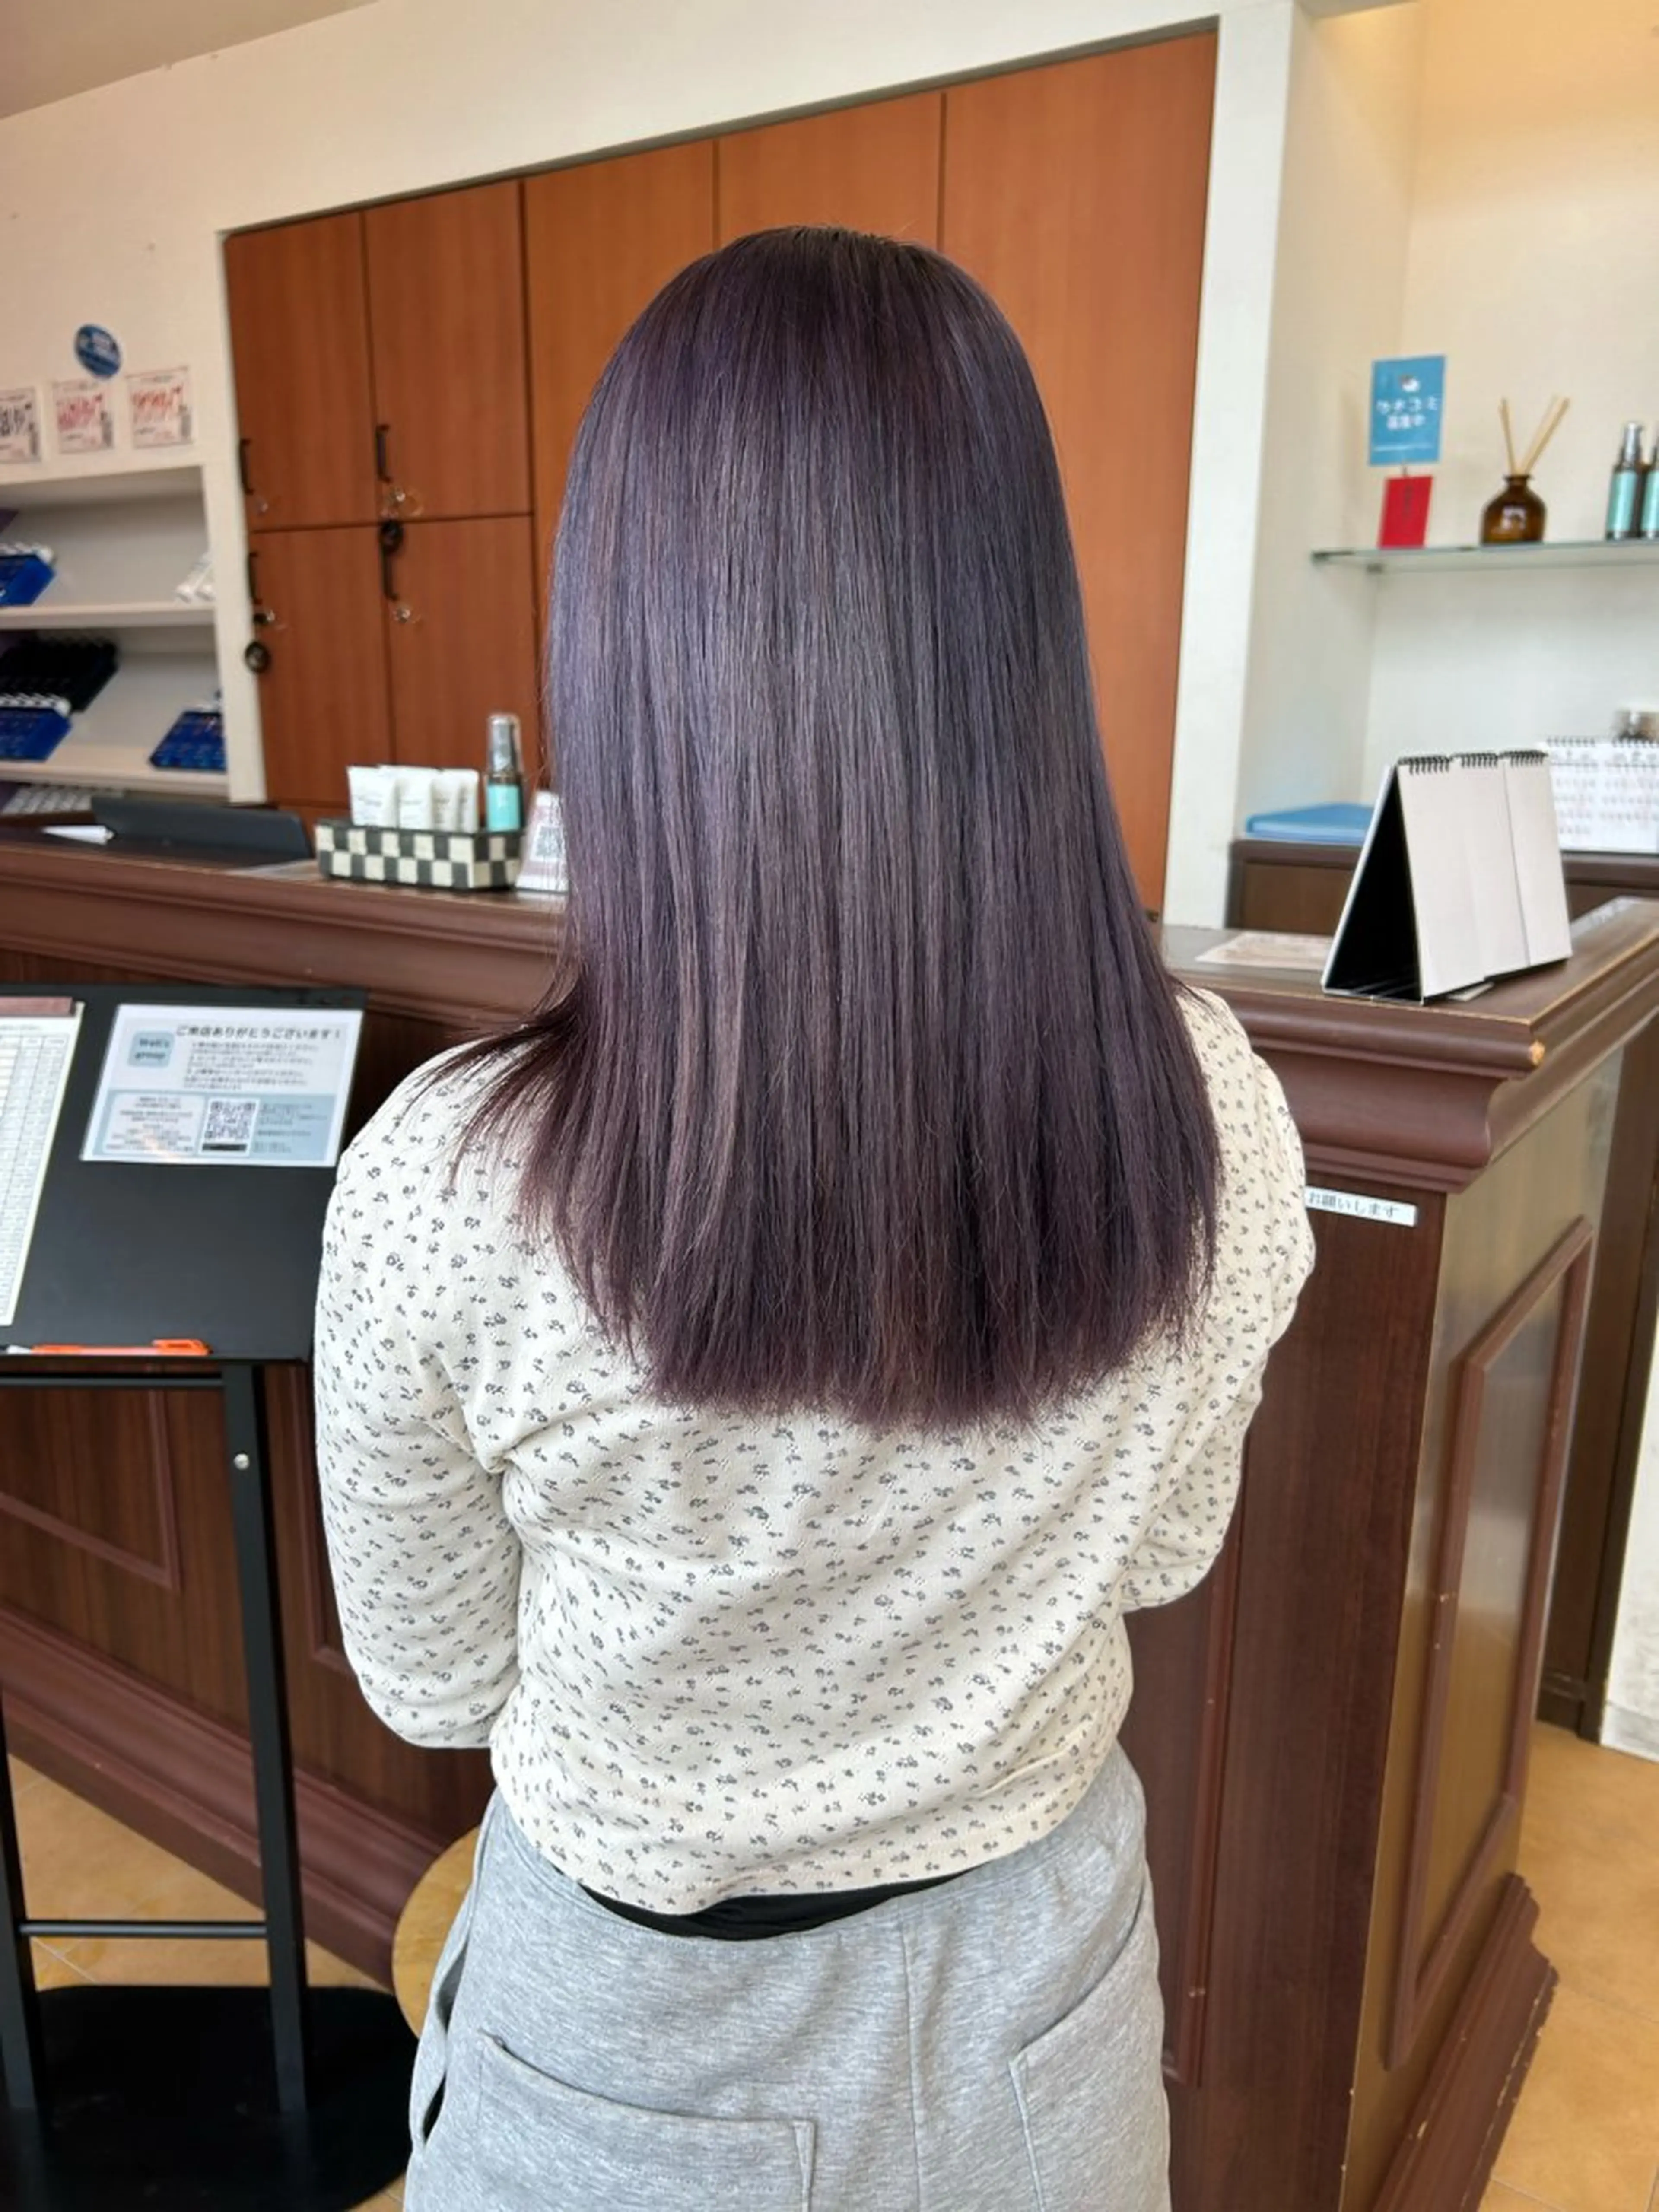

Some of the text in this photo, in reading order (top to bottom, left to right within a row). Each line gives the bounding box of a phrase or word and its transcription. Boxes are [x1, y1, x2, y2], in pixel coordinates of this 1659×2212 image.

[1309, 1192, 1400, 1218] お願いします
